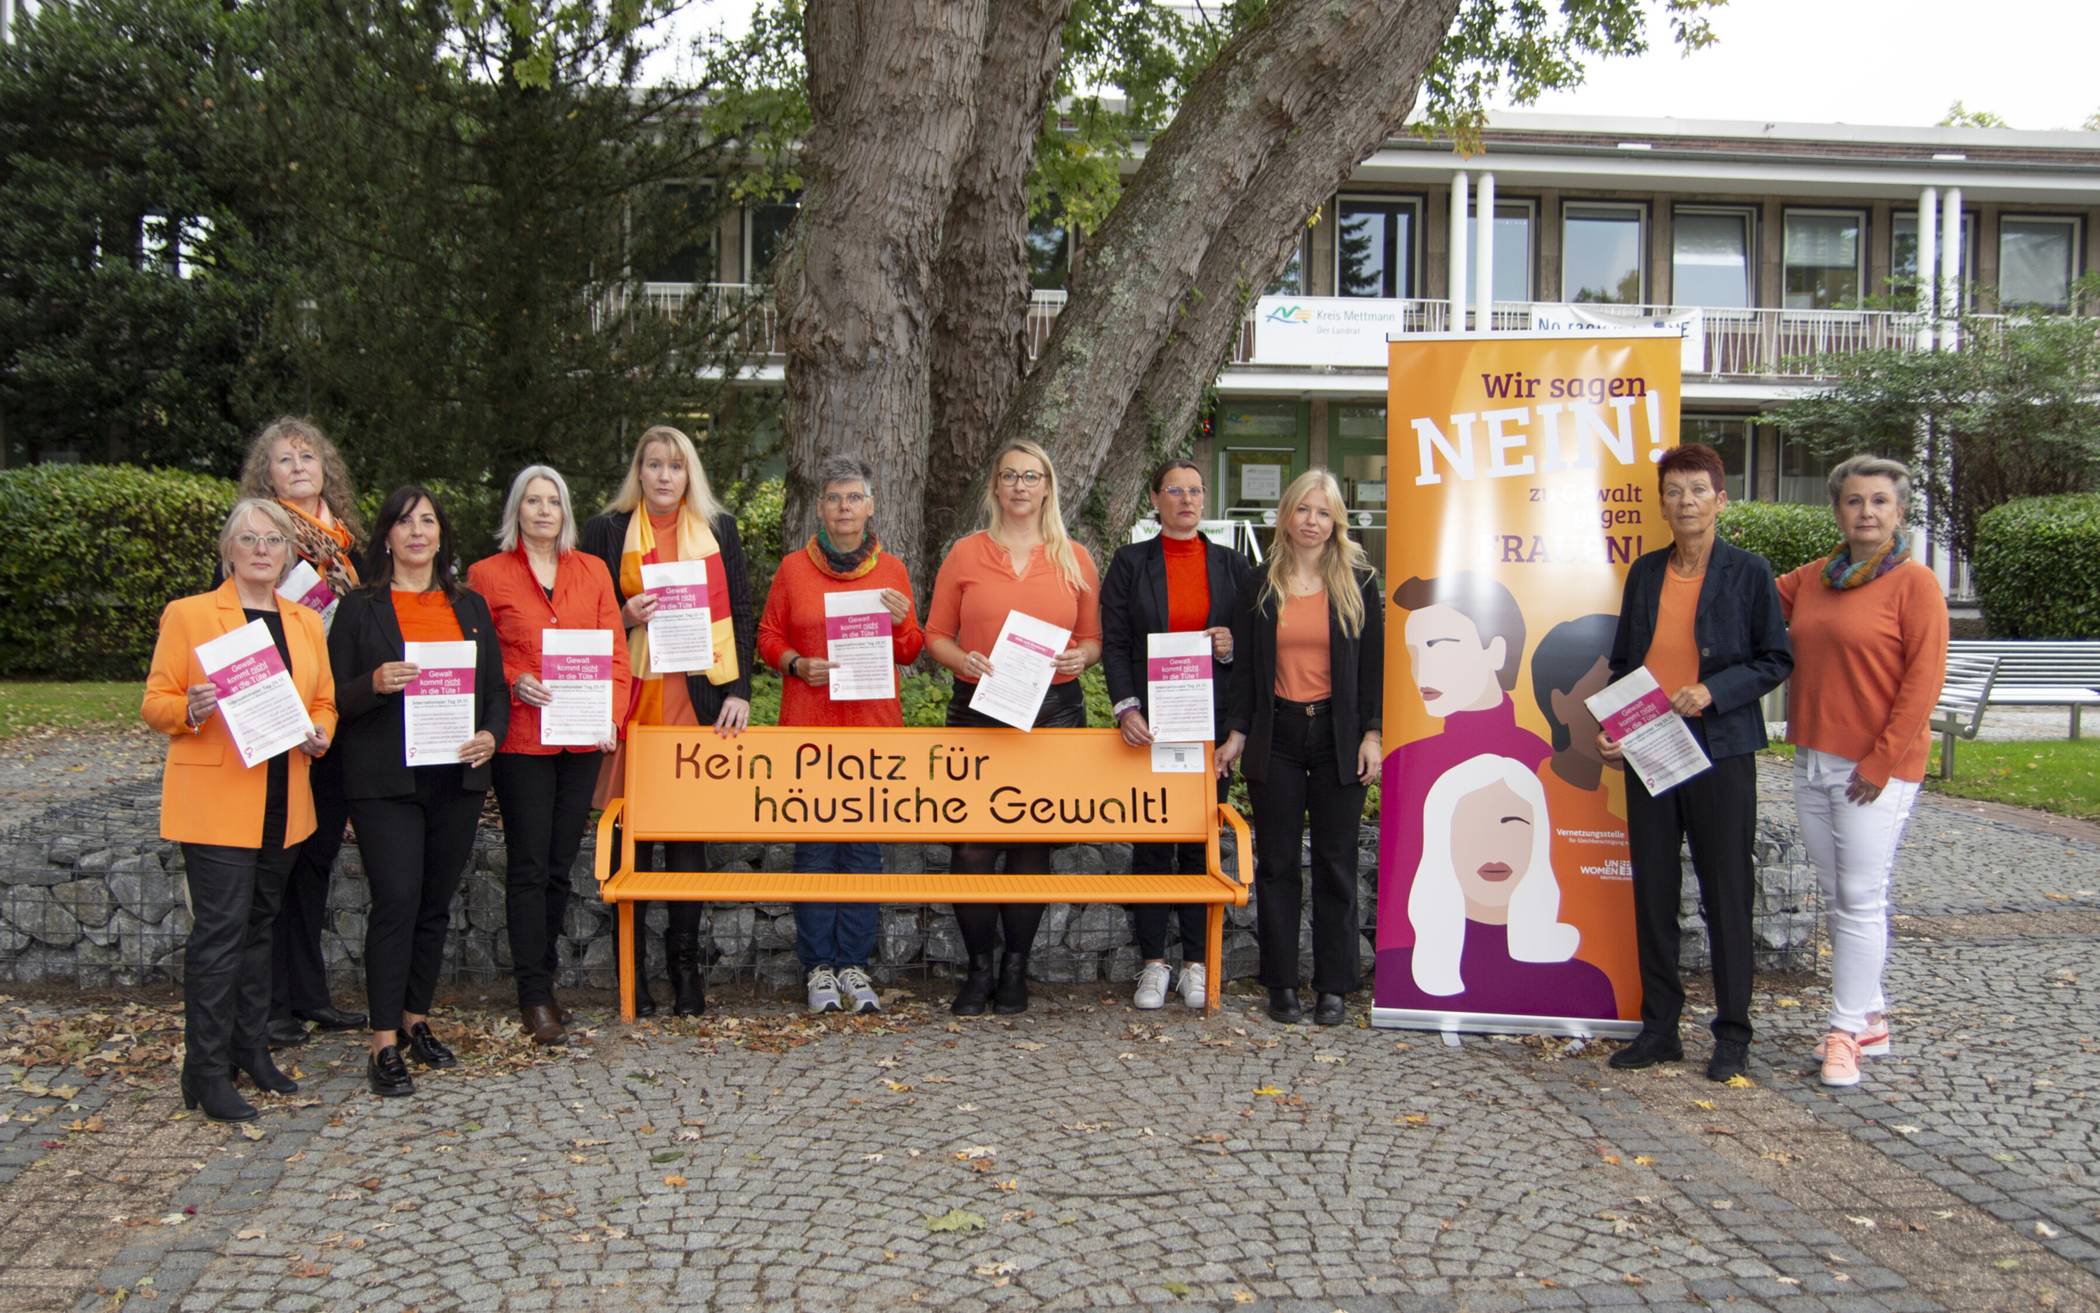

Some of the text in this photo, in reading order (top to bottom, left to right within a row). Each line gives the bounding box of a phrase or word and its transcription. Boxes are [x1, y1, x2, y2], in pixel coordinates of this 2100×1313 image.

[1317, 310, 1396, 321] Kreis Mettmann
[1332, 326, 1360, 334] Landrat
[1482, 372, 1647, 405] Wir sagen
[1411, 390, 1665, 486] NEIN!
[582, 664, 598, 672] nicht
[444, 678, 461, 686] nicht
[676, 743, 990, 781] Kein Platz für
[754, 786, 1168, 824] häusliche Gewalt!
[1556, 828, 1624, 838] Vernetzungsstelle
[1580, 866, 1618, 875] WOMEN
